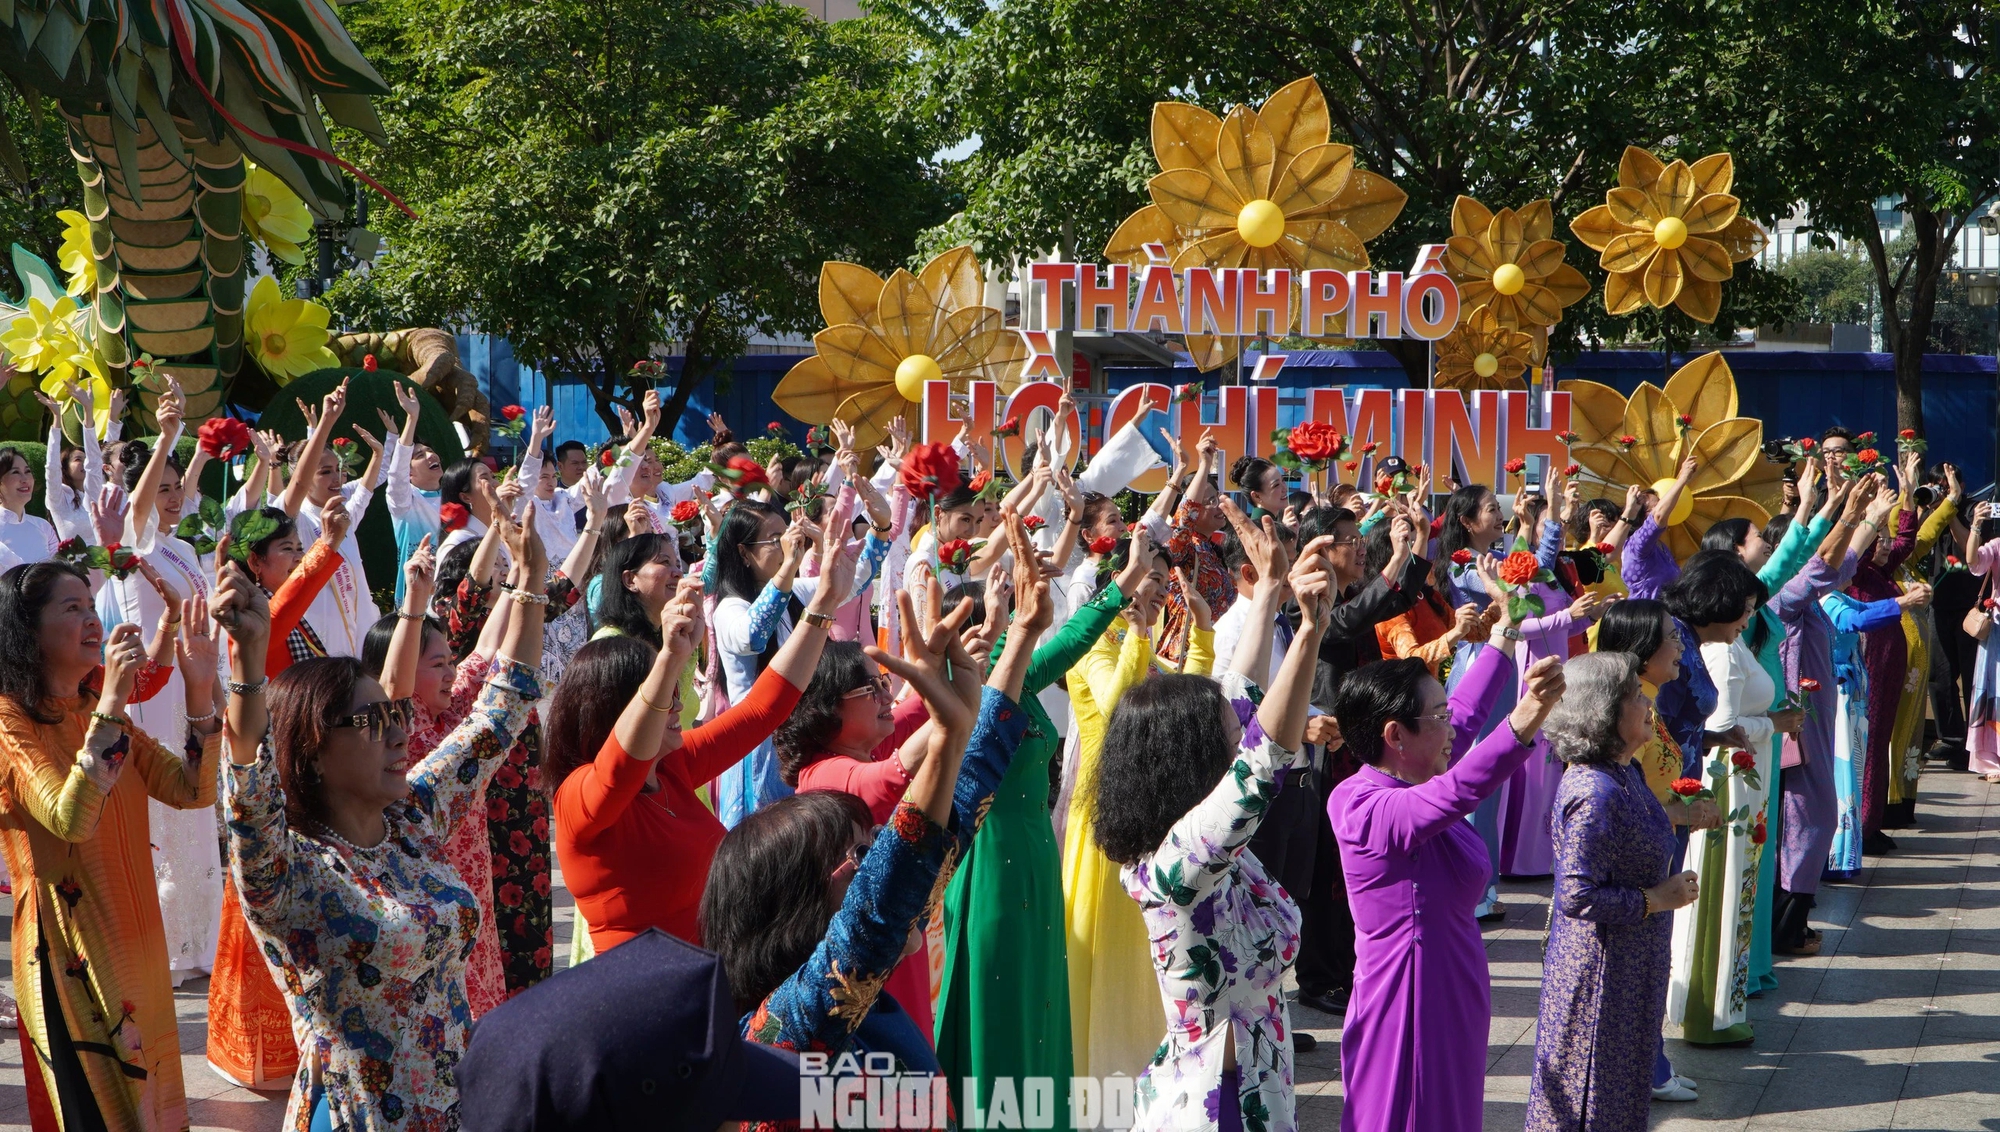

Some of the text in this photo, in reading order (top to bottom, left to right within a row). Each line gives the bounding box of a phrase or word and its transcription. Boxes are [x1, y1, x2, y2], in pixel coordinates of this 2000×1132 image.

[1028, 243, 1460, 340] THÀNH PHỐ
[923, 330, 1572, 496] HỒ CHÍ MINH
